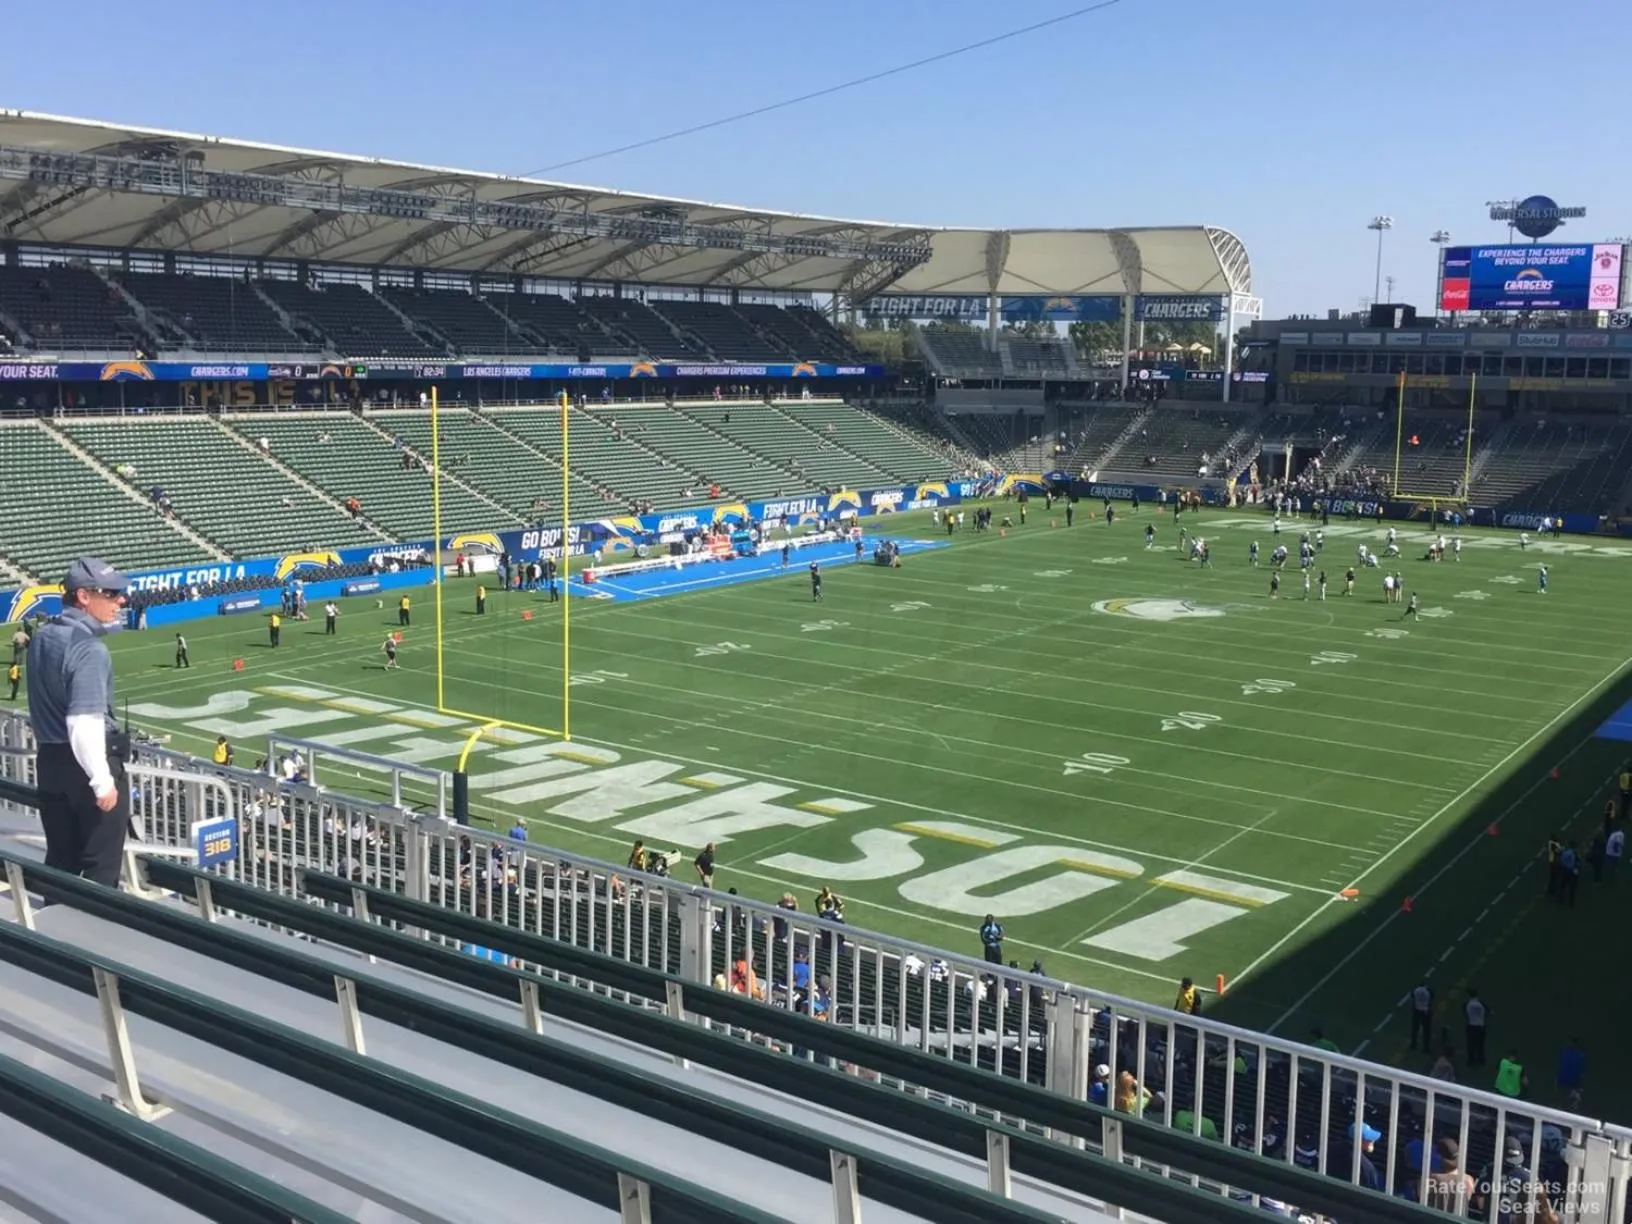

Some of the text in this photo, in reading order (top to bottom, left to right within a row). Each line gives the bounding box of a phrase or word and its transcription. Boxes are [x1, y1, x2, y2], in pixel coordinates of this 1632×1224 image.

[1479, 247, 1586, 258] EXPERIENCE THE CHARGERS
[1494, 257, 1526, 266] BEYOND
[1526, 257, 1548, 265] YOUR
[1504, 280, 1555, 291] CHARGERS
[870, 298, 980, 316] FIGHT FOR LA
[1144, 303, 1213, 318] CHARGERS
[0, 366, 59, 379] YOUR SEAT.
[190, 366, 249, 377] CHARGERS.COM
[295, 366, 302, 377] 0
[463, 367, 476, 377] LOS
[1090, 486, 1136, 499] CHARGERS
[521, 526, 580, 550] GO BOS!
[1062, 752, 1131, 776] 10
[204, 829, 231, 842] SECTION
[204, 838, 232, 857] 318
[756, 820, 1293, 962] LOS
